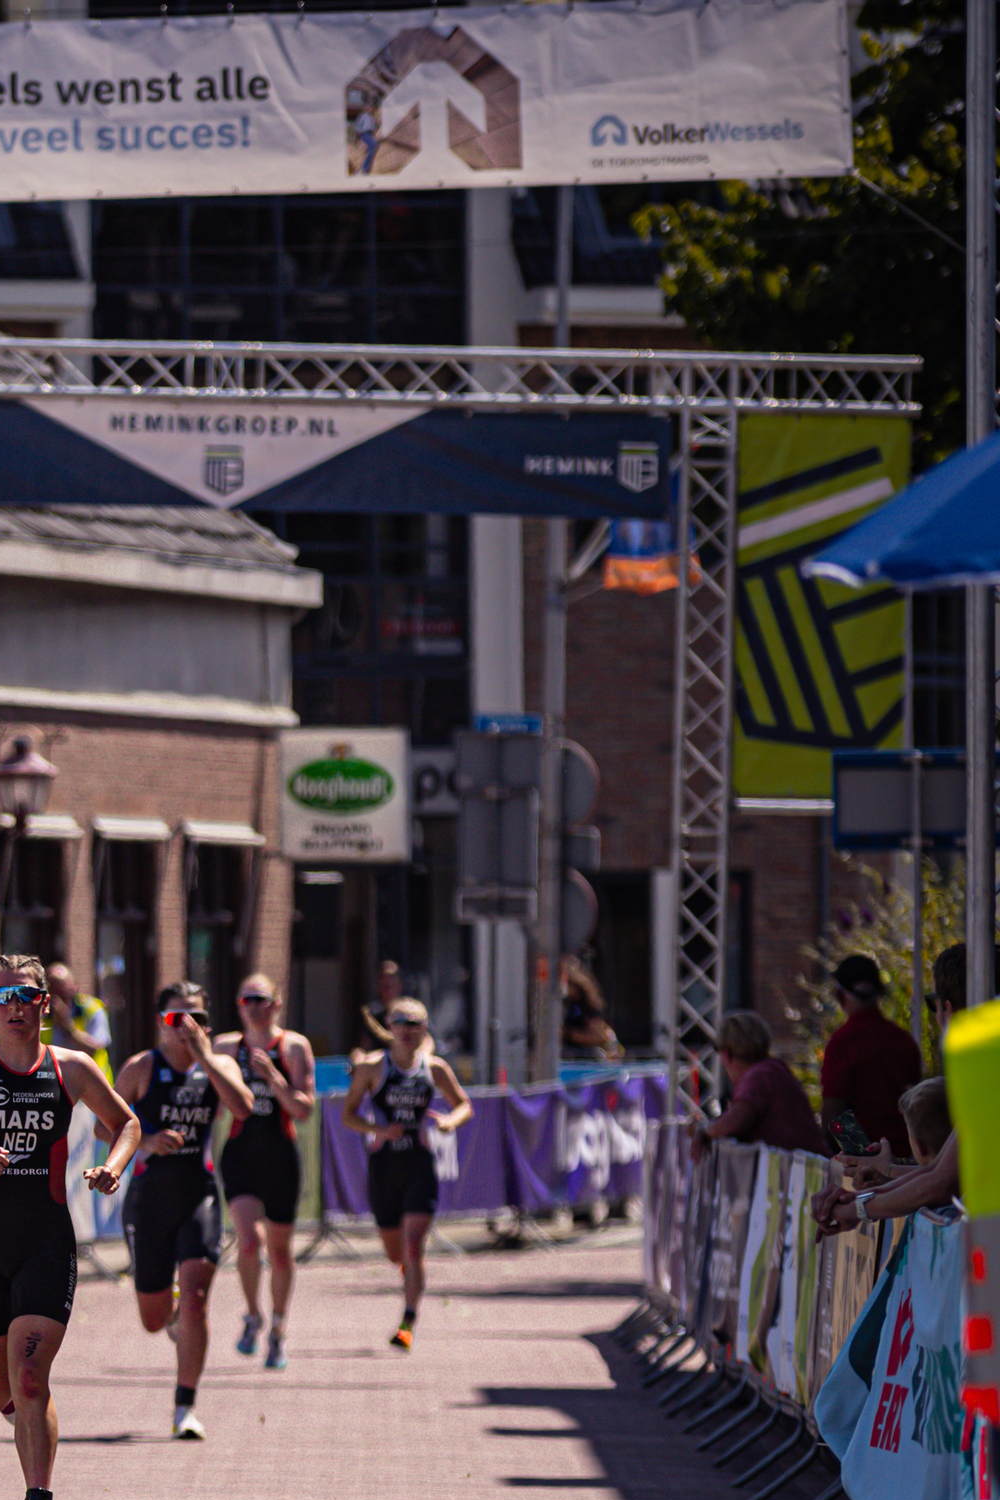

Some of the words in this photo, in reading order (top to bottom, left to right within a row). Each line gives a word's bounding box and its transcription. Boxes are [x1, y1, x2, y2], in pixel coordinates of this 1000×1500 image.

[55, 71, 184, 105] wenst
[196, 67, 271, 101] alle
[95, 116, 252, 151] succes!
[632, 118, 804, 146] VolkerWessels
[110, 413, 340, 437] HEMINKGROEP.NL
[525, 454, 614, 476] HEMINK
[160, 1104, 212, 1124] FAIVRE
[2, 1132, 38, 1152] NED
[1, 1168, 49, 1176] GEBORGH
